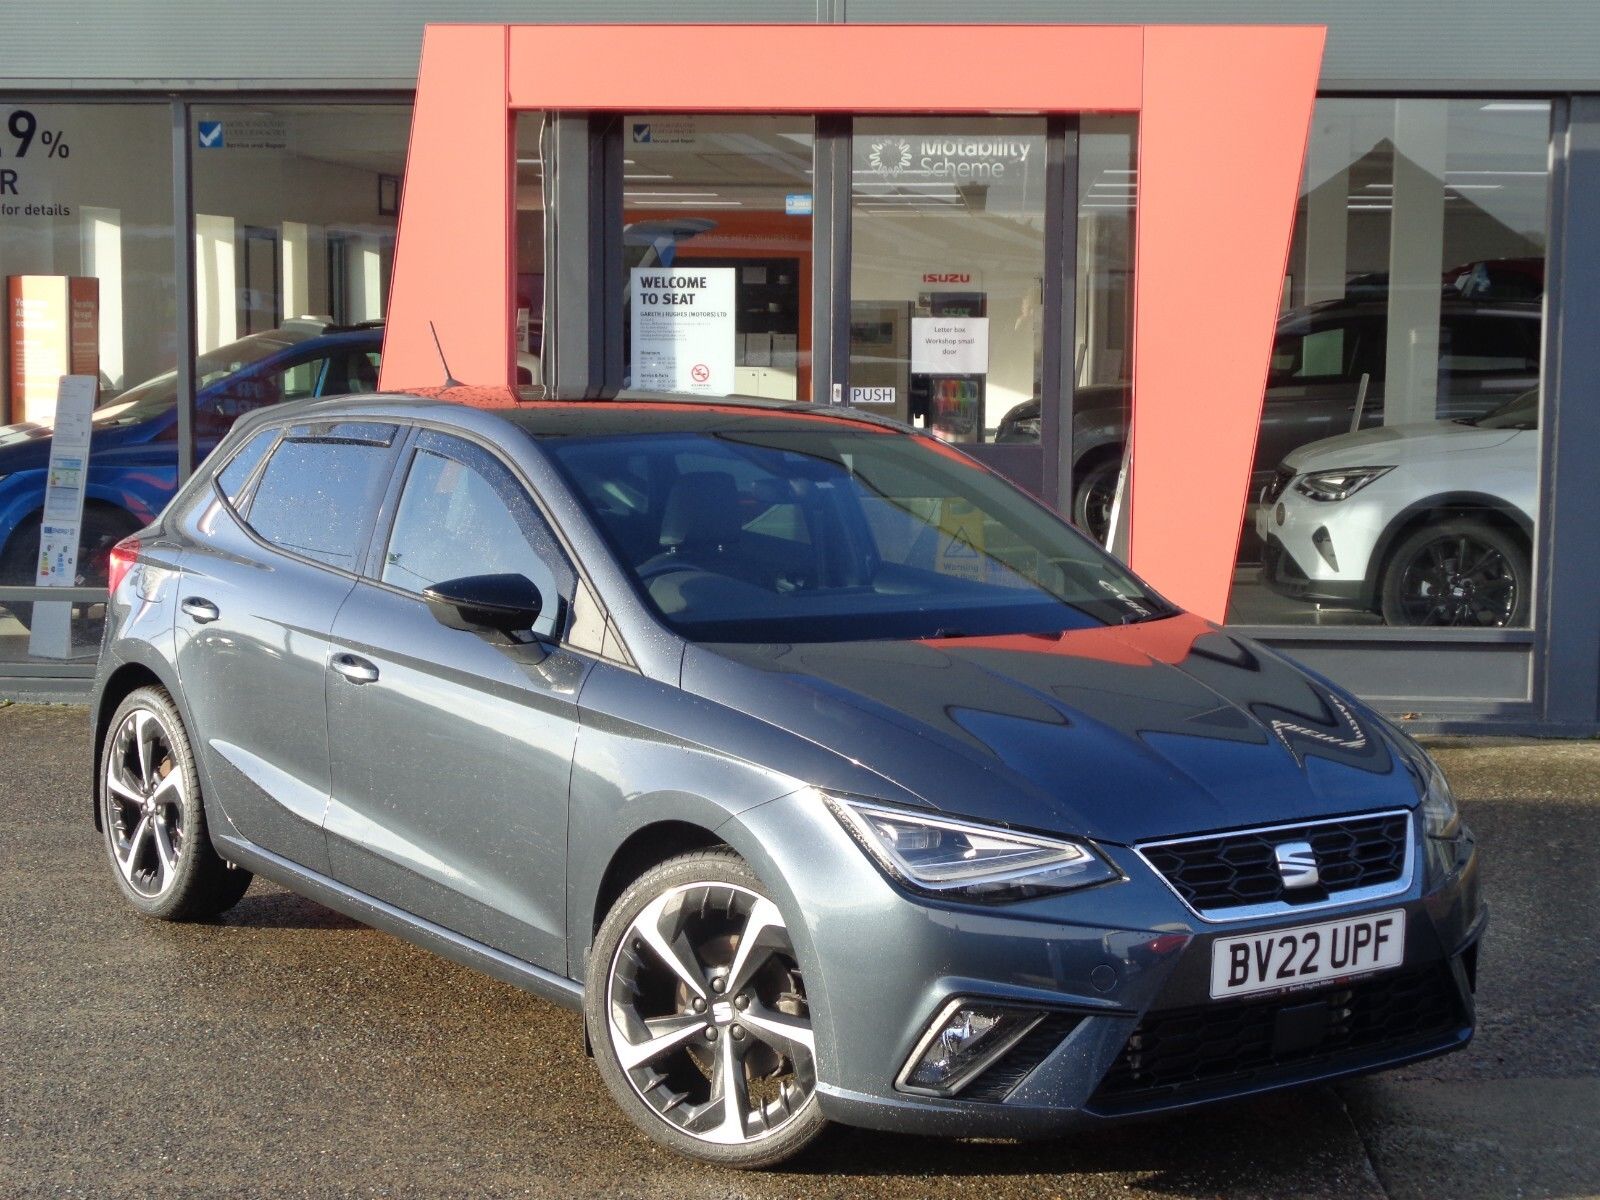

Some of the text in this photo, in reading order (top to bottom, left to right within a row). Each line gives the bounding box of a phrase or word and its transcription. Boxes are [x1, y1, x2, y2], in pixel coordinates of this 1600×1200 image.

[921, 139, 1031, 162] Motability
[920, 157, 1005, 177] Scheme
[1, 203, 71, 217] for details
[640, 276, 707, 289] WELCOME
[922, 273, 970, 283] ISUZU
[640, 293, 696, 305] TO SEAT
[853, 388, 892, 401] PUSH
[1227, 918, 1393, 987] BV22 UPF
